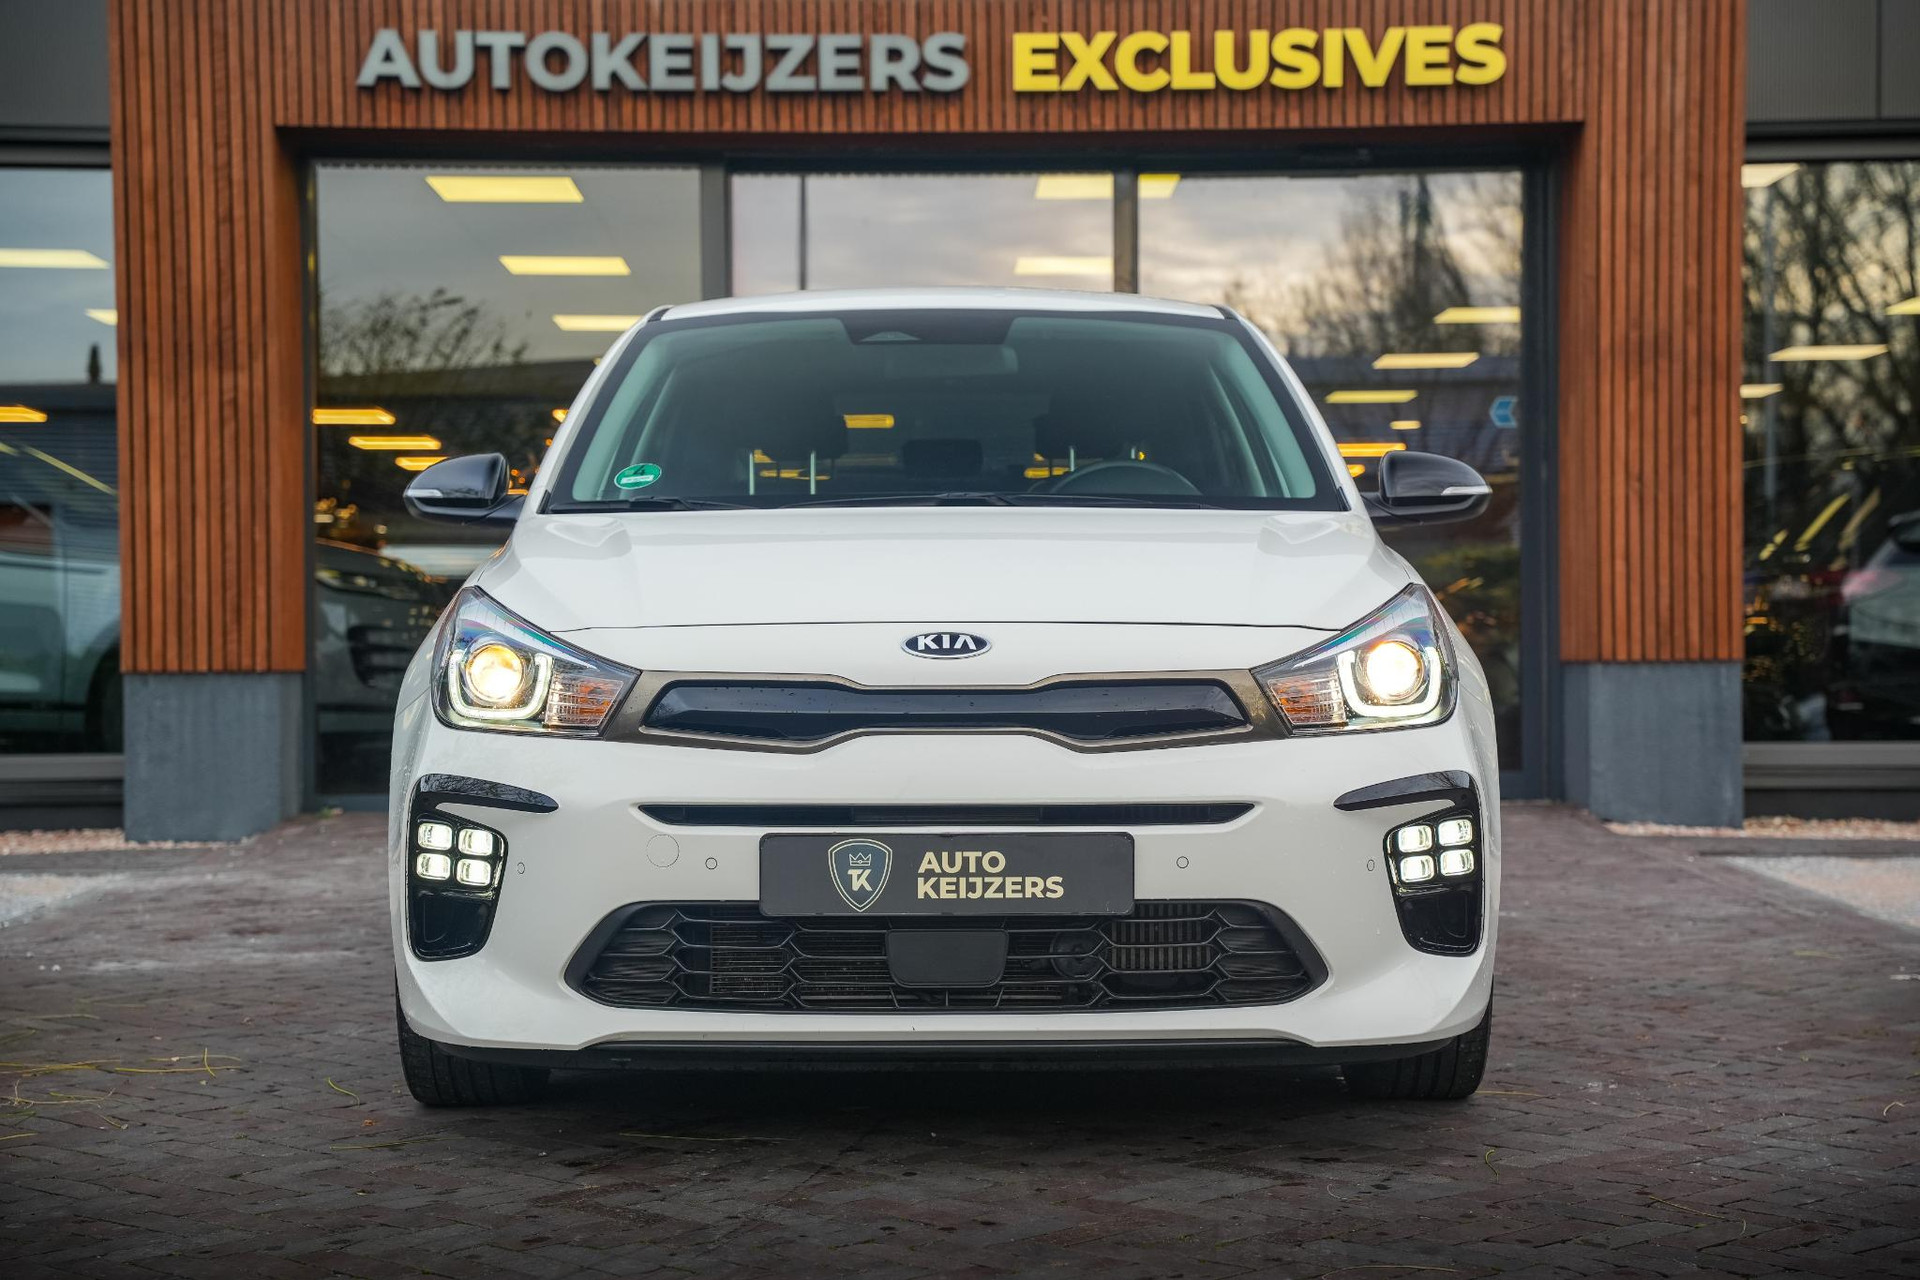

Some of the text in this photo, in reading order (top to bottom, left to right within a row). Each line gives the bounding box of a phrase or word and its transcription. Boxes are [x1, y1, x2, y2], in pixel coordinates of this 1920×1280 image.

[356, 22, 1507, 92] AUTOKEIJZERS EXCLUSIVES
[917, 634, 977, 650] KIA
[918, 851, 1006, 873] AUTO
[847, 868, 873, 892] TK
[917, 876, 1064, 899] KEIJZERS
